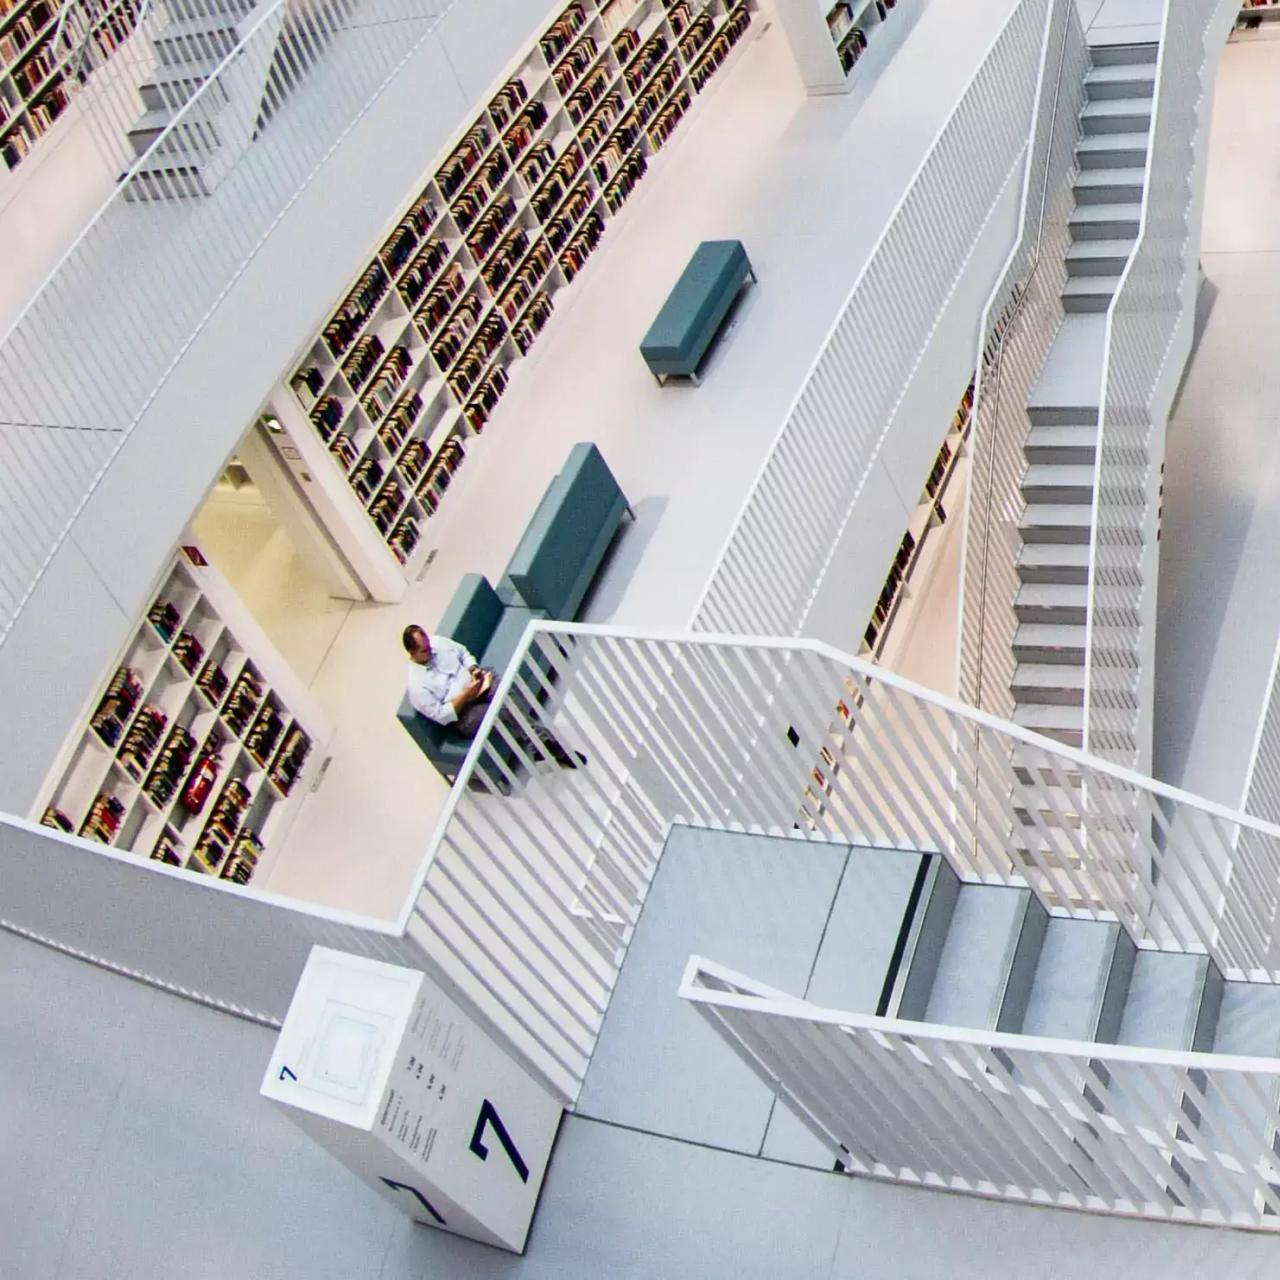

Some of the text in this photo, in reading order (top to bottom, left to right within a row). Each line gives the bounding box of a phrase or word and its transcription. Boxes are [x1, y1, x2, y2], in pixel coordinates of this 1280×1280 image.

[278, 1064, 298, 1083] 7
[468, 1098, 530, 1185] 7
[379, 1175, 447, 1225] 7
